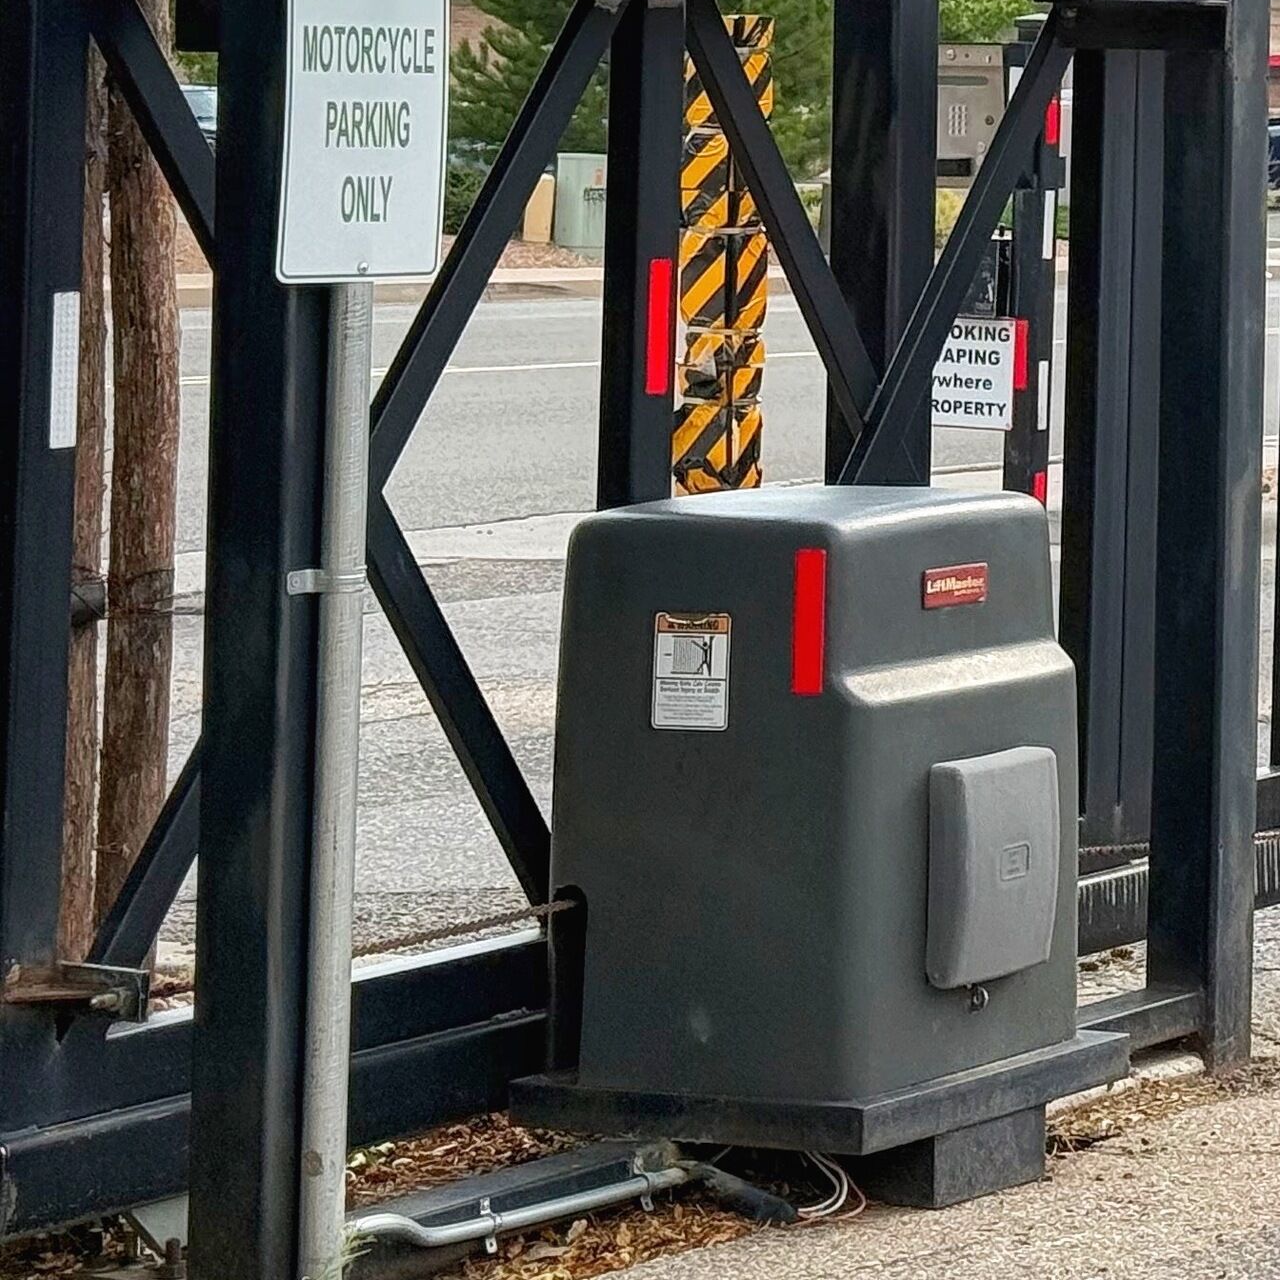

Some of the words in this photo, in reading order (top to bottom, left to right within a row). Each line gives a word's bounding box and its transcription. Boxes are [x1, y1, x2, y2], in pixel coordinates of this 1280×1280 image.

[302, 25, 435, 74] MOTORCYCLE
[325, 101, 410, 148] PARKING
[341, 176, 393, 223] ONLY
[951, 325, 1010, 342] OKING
[943, 348, 1001, 365] APING
[932, 372, 993, 390] where
[931, 399, 1006, 417] ROPERTY
